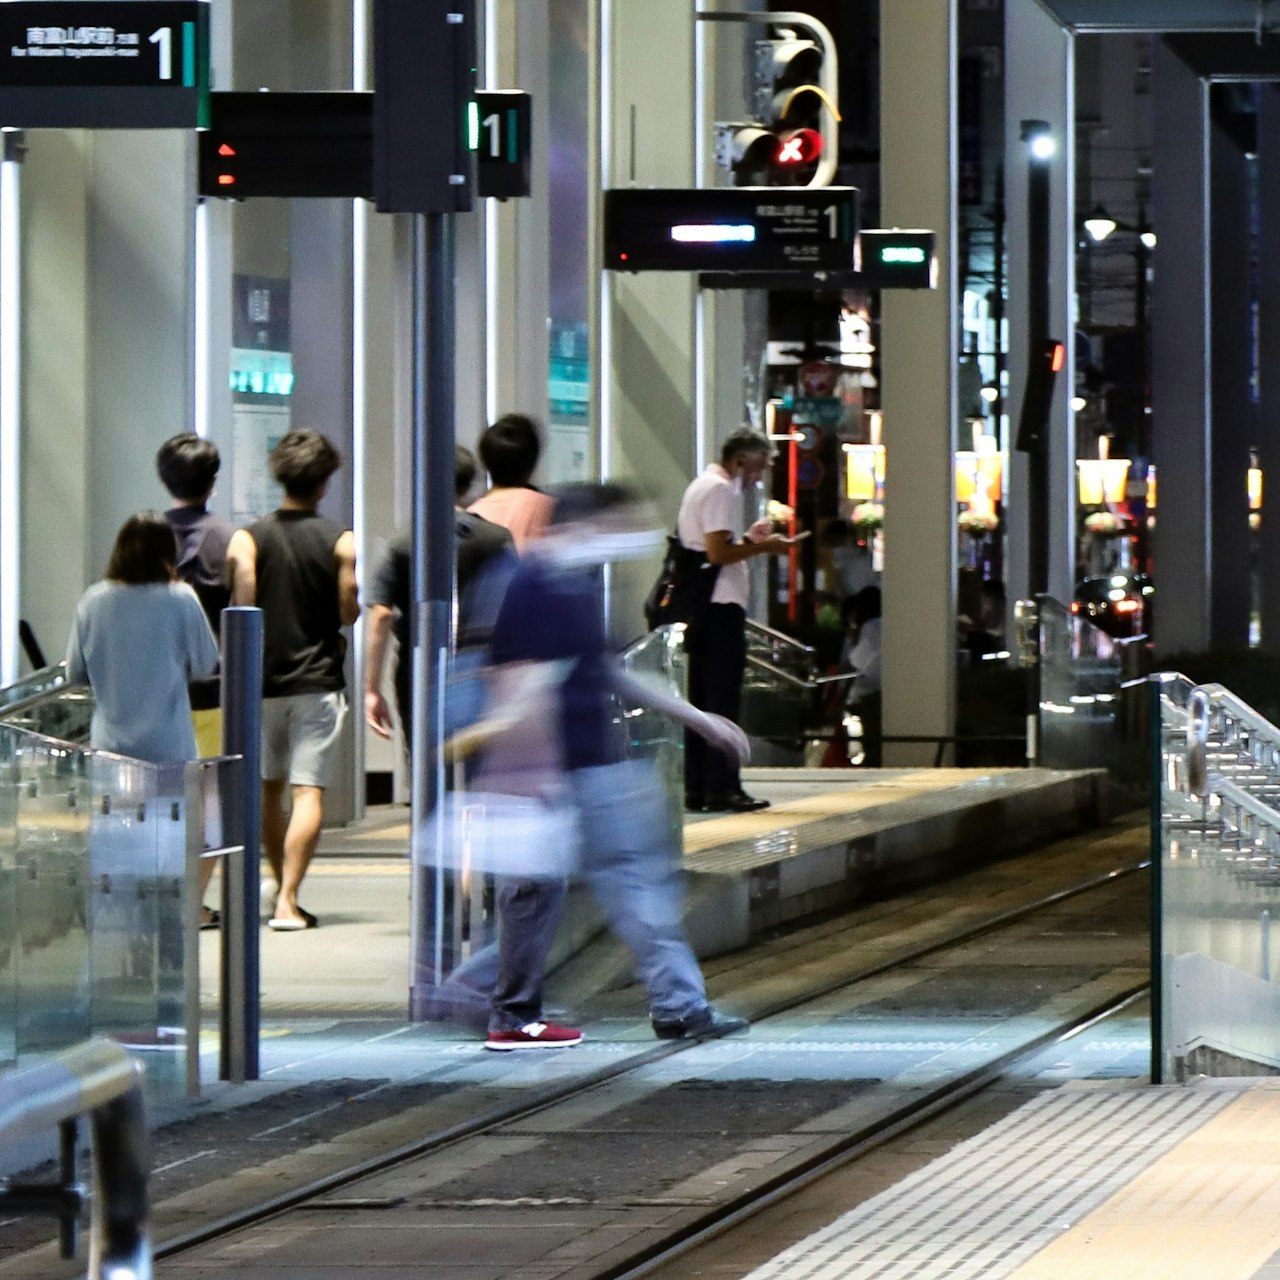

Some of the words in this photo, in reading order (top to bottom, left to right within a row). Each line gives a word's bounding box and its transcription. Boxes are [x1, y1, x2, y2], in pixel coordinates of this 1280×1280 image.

[148, 26, 172, 80] 1
[481, 113, 500, 158] 1
[823, 205, 837, 239] 1
